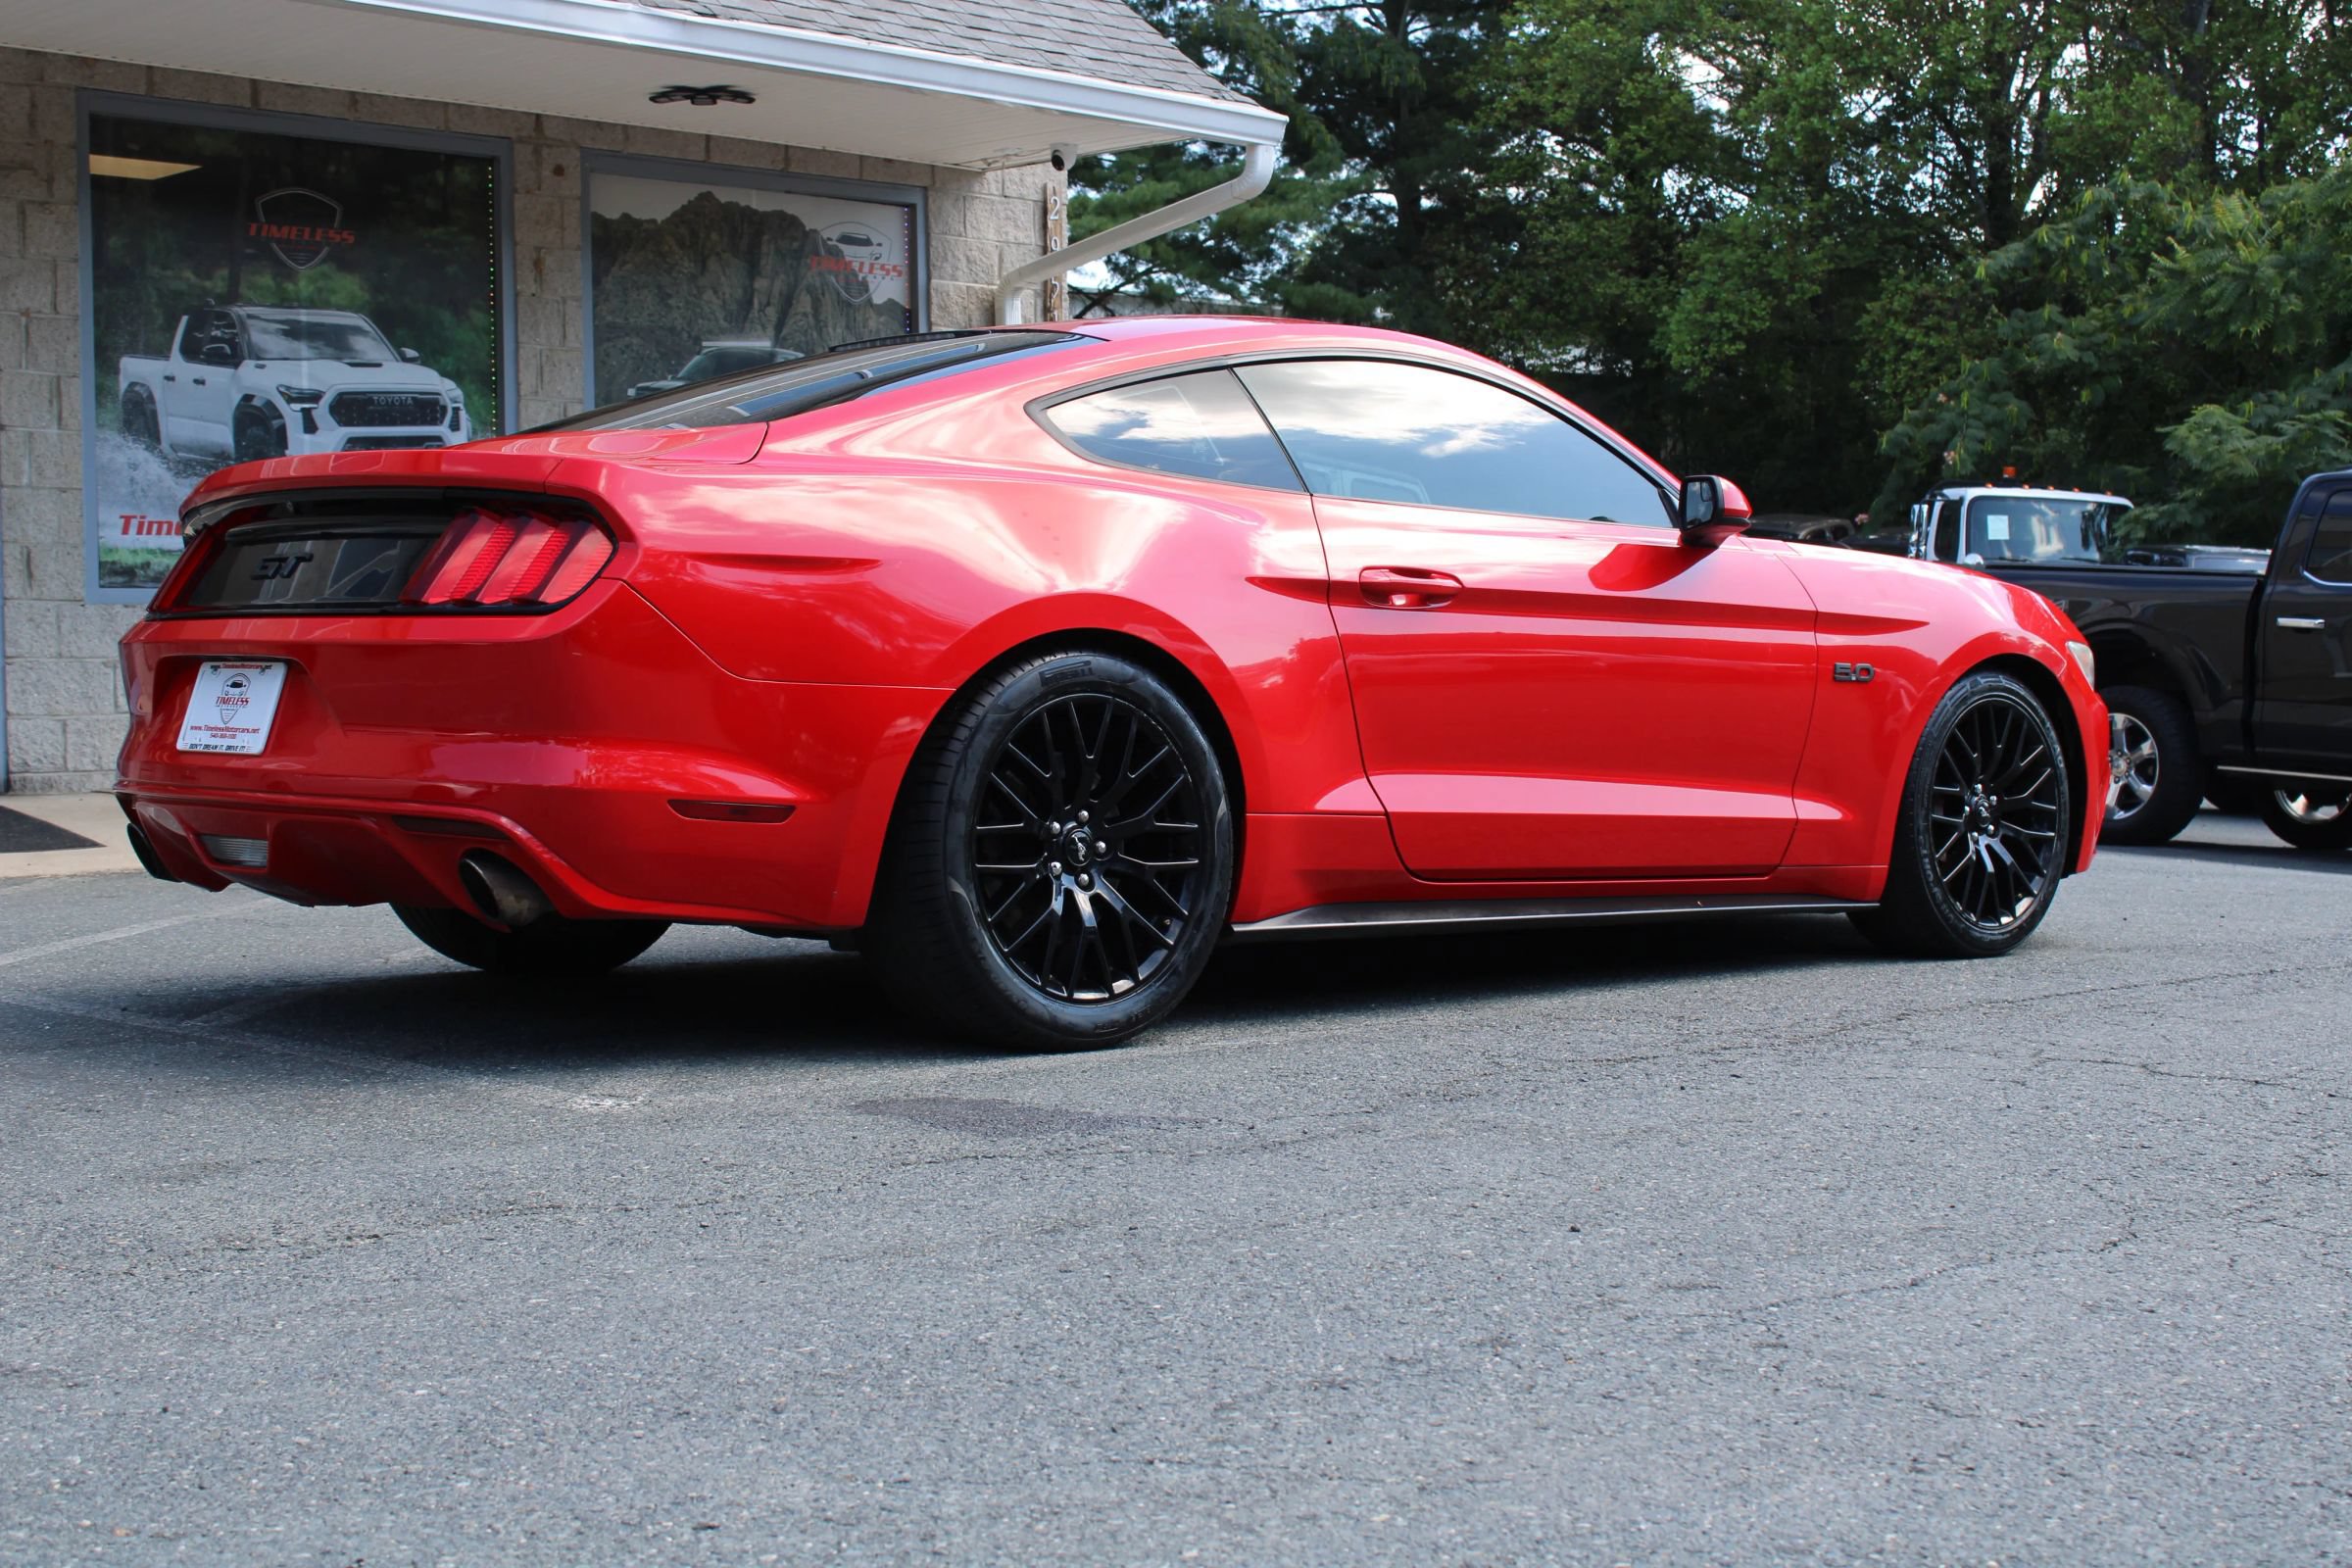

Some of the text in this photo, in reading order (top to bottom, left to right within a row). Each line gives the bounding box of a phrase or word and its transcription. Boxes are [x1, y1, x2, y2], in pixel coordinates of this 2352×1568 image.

[247, 222, 356, 244] TIMELESS
[809, 254, 904, 278] TIMELESS
[372, 396, 415, 406] TOYOTA
[250, 553, 314, 580] GT
[1834, 662, 1875, 682] 5.0
[216, 696, 251, 706] TIMELESS
